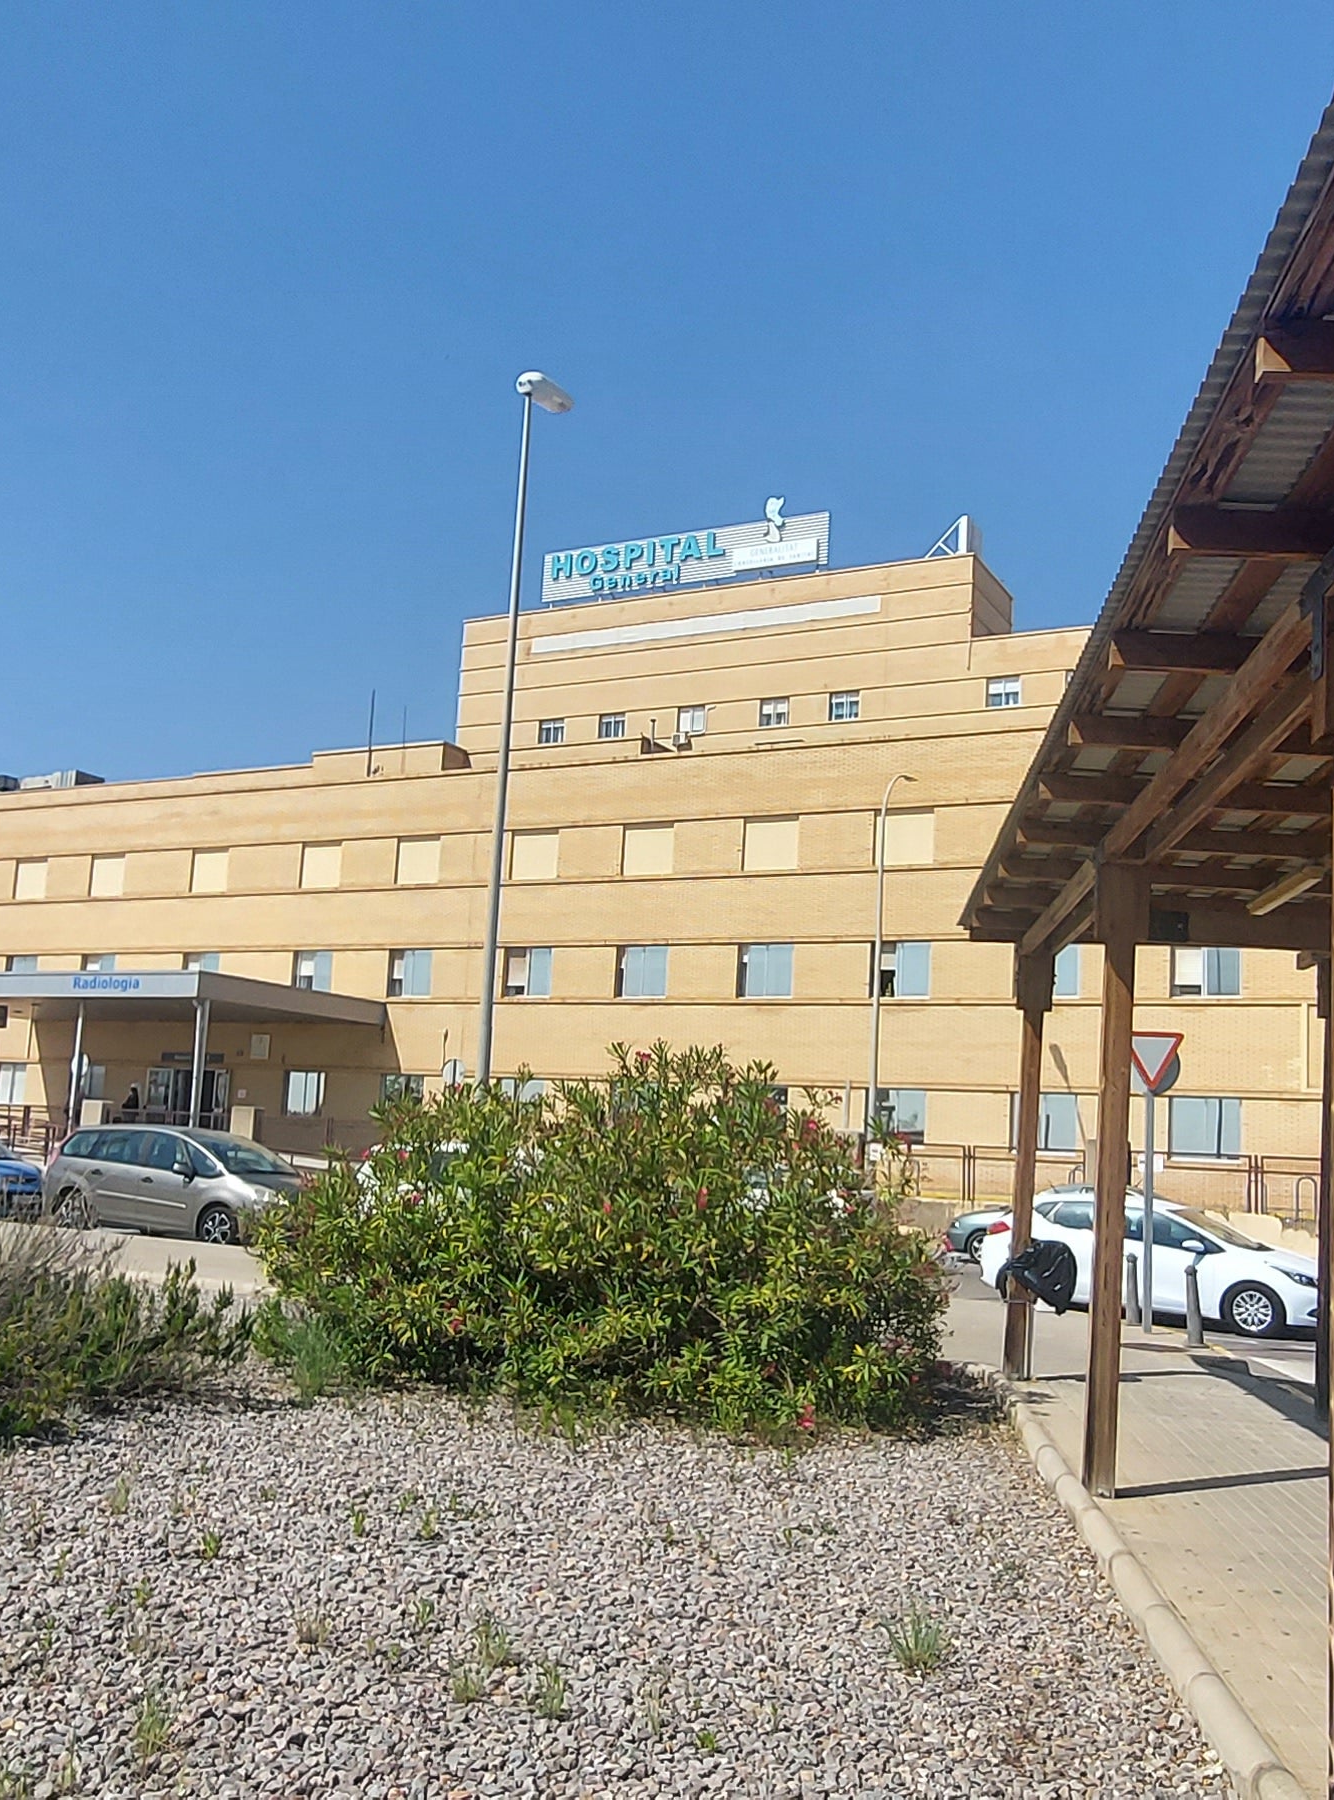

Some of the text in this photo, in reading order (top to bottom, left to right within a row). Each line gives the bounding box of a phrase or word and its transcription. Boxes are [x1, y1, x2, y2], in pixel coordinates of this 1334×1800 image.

[551, 531, 725, 580] HOSPITAL
[589, 563, 681, 591] General
[73, 976, 140, 992] Radiologia
